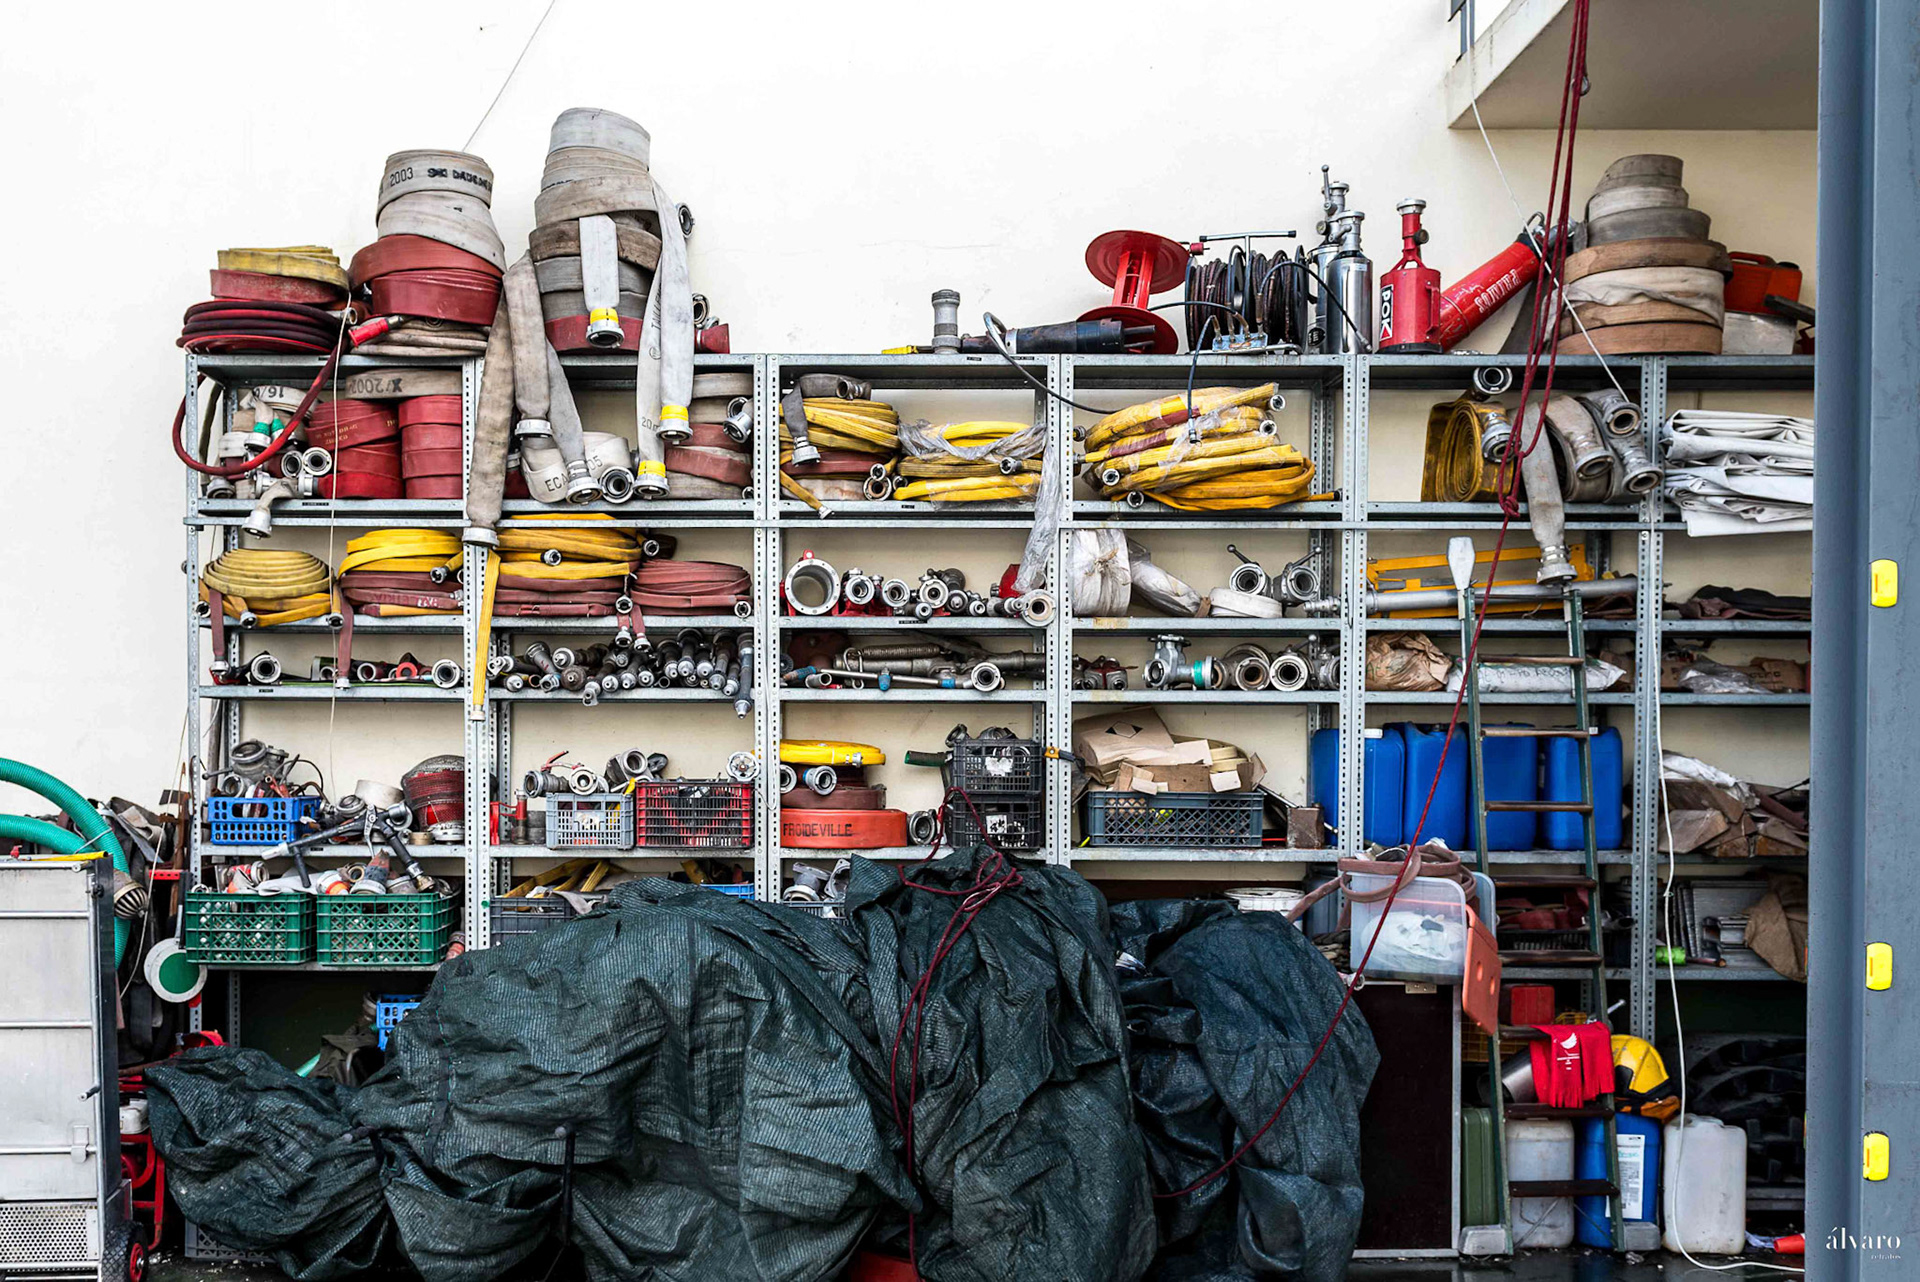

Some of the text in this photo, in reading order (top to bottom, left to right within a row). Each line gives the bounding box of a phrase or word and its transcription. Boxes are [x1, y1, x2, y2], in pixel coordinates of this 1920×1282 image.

[390, 166, 414, 187] 2003
[1474, 268, 1522, 313] PRIMUS
[1381, 289, 1393, 340] POK
[783, 823, 853, 837] FROIDEVILLE
